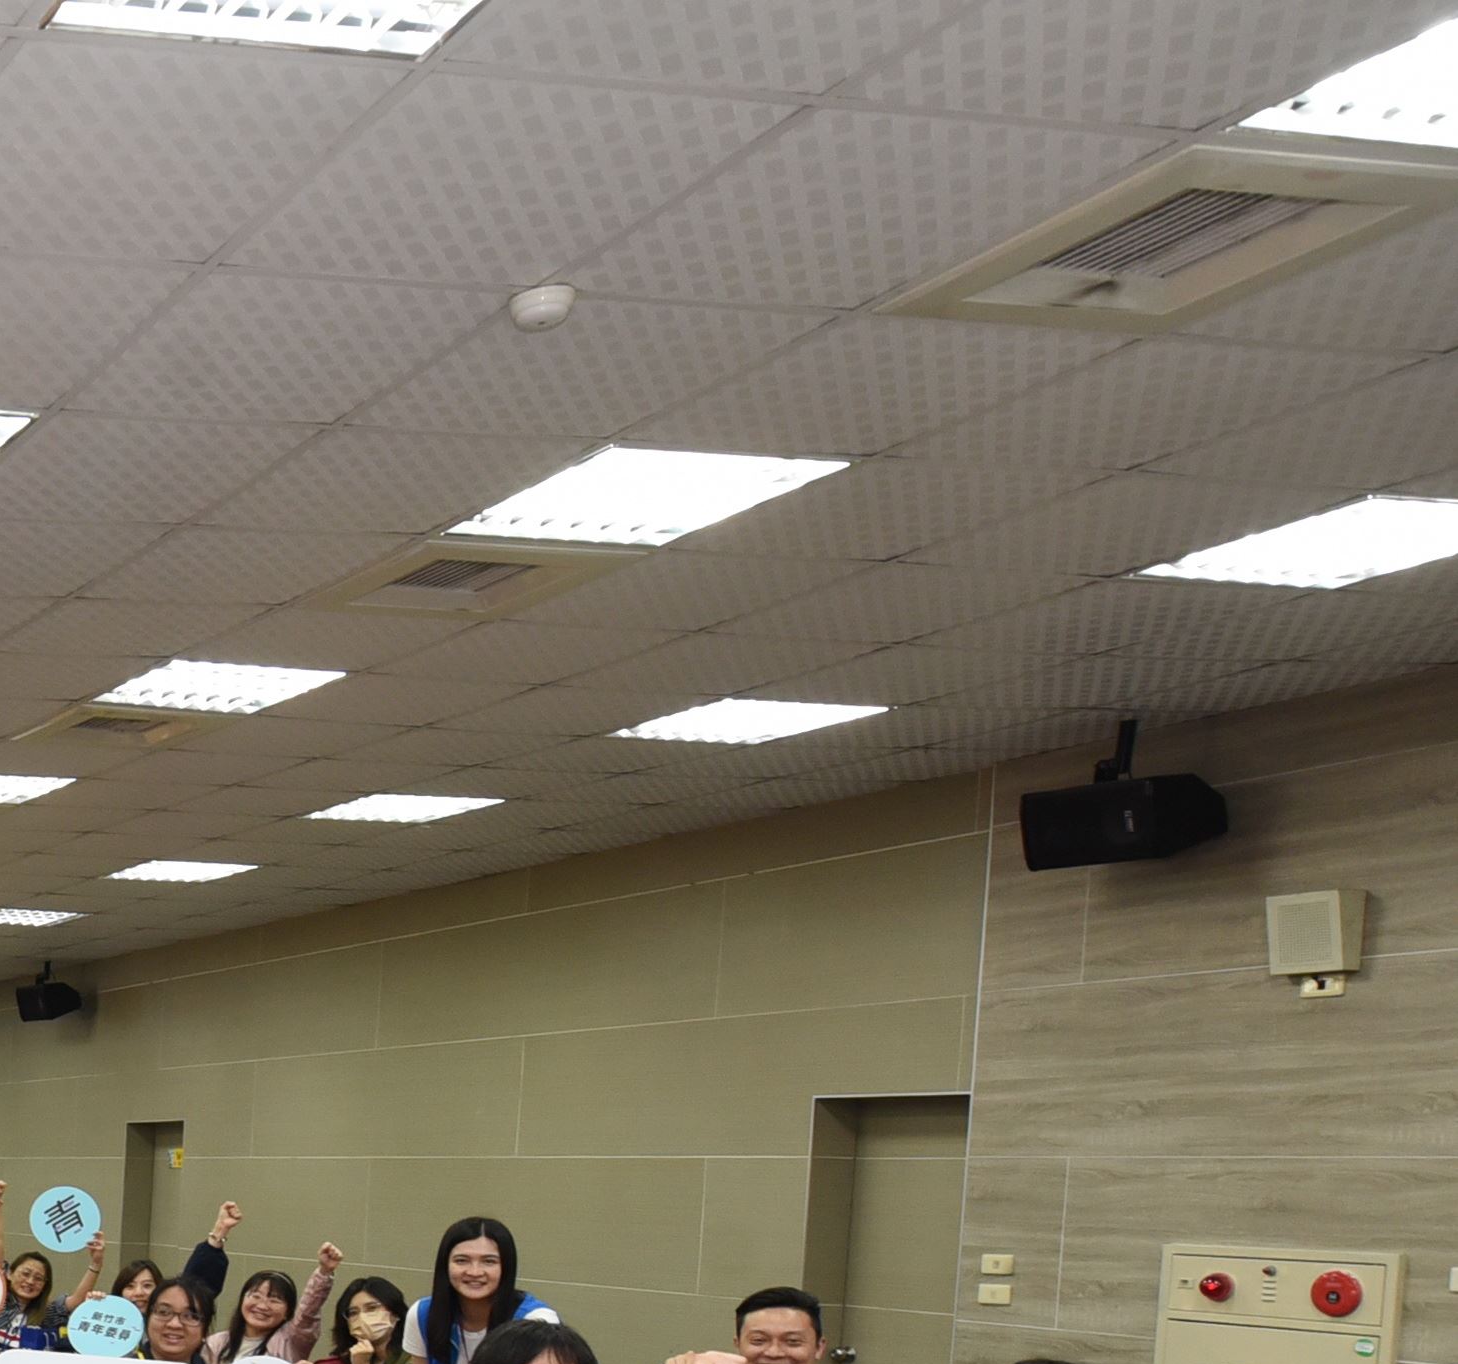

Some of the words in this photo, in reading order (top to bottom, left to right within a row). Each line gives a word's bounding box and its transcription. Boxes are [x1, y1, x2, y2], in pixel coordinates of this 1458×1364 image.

[43, 1194, 84, 1243] 青
[91, 1311, 126, 1326] 新竹市
[77, 1320, 131, 1342] 青年委員
